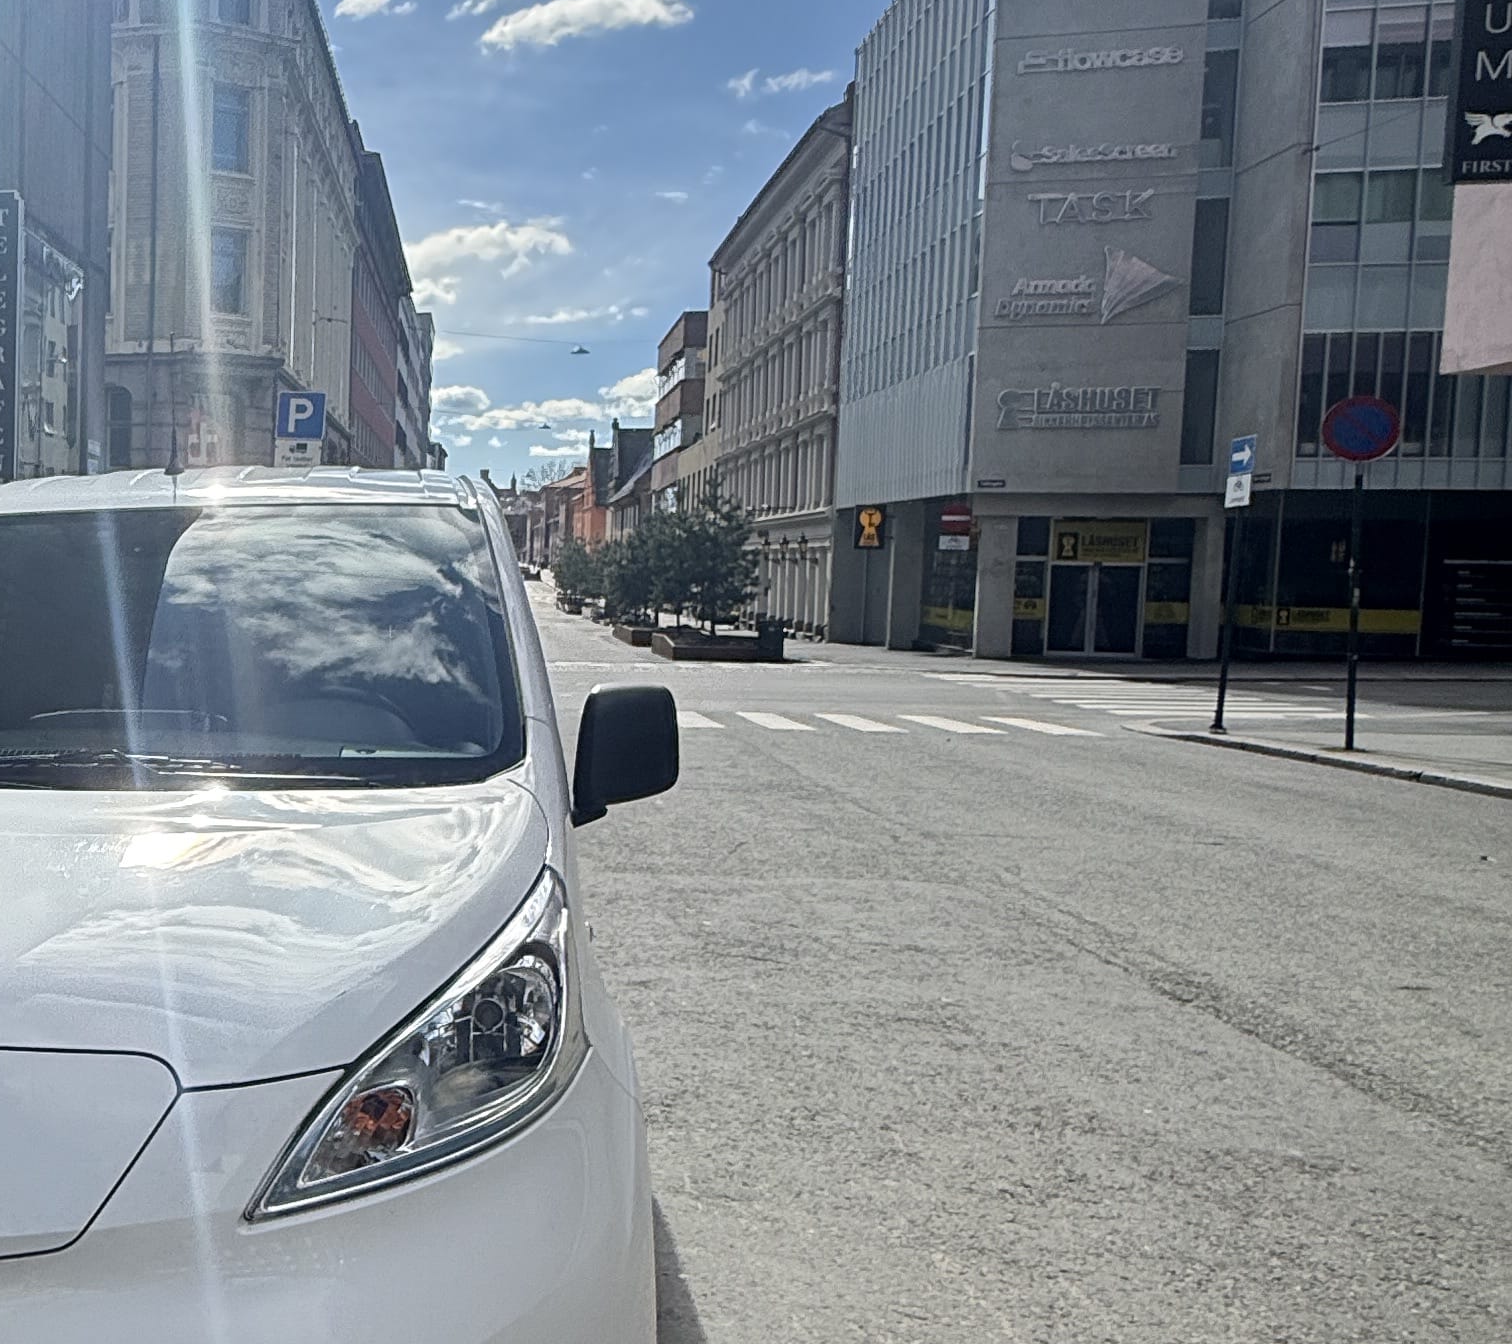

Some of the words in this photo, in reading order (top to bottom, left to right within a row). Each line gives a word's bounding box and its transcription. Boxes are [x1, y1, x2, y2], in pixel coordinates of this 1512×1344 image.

[1058, 47, 1184, 71] flowcase
[1027, 188, 1154, 224] TASK
[1034, 381, 1162, 411] LÅSHUSET
[288, 398, 313, 433] P
